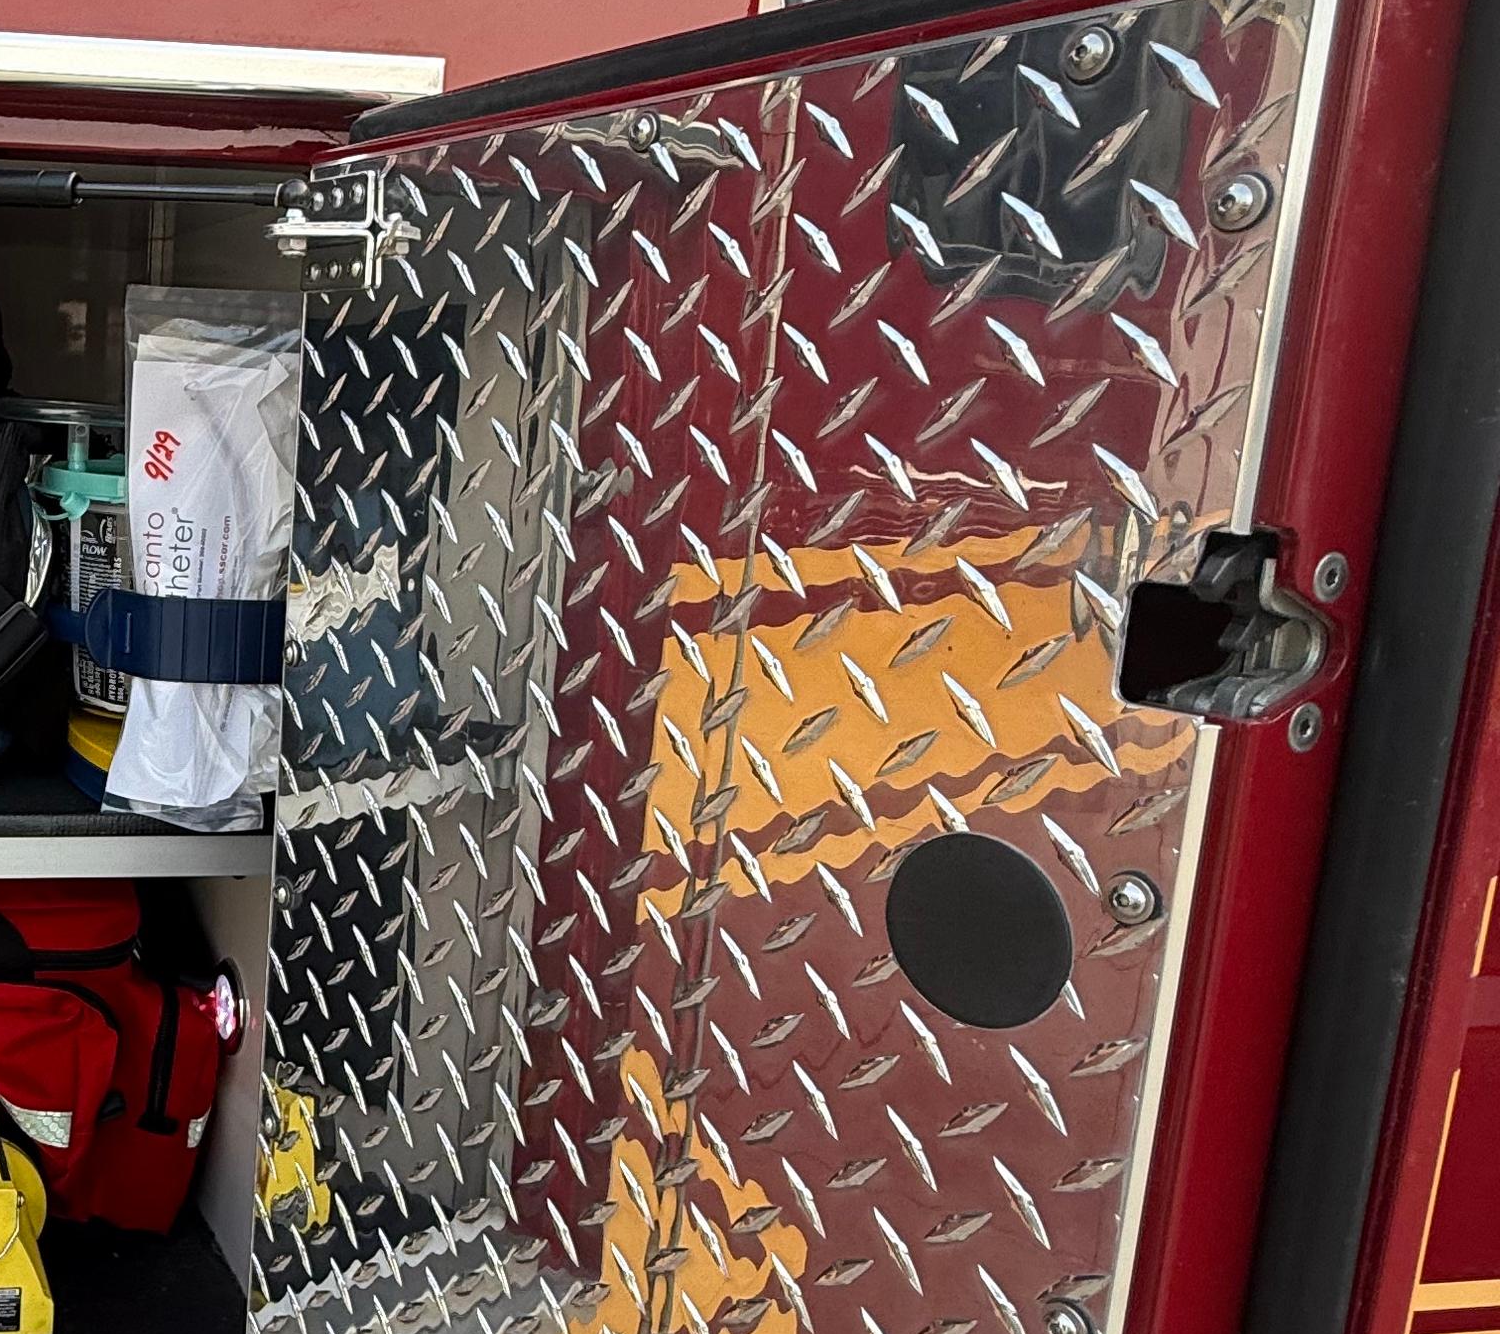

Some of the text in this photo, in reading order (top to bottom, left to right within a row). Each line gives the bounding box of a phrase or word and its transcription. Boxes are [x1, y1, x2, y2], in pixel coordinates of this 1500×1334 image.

[144, 430, 181, 481] 9/29
[142, 512, 164, 597] canto
[216, 515, 231, 599] hop.sscor.com
